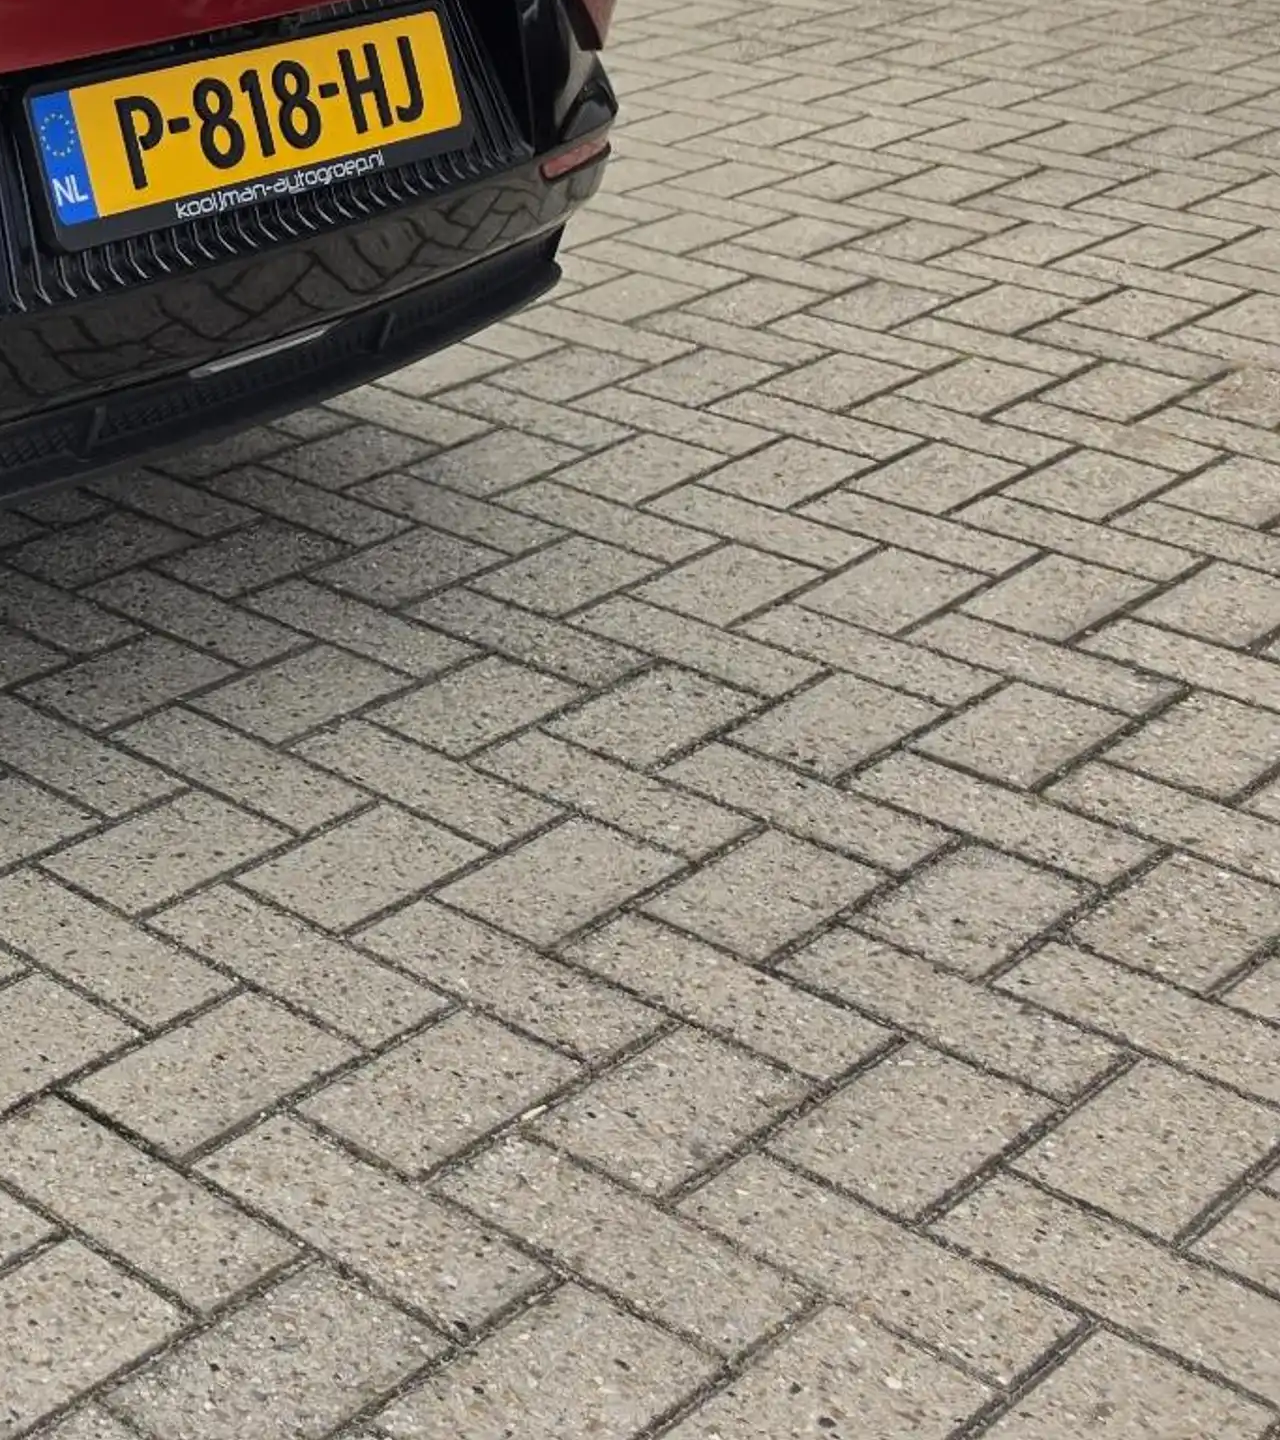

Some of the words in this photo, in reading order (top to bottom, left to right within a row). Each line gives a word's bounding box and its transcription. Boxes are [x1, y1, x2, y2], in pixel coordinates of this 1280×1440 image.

[51, 173, 90, 208] NL
[113, 35, 425, 192] P-818-HJ
[174, 150, 385, 219] kooijman-autogroep.nl
